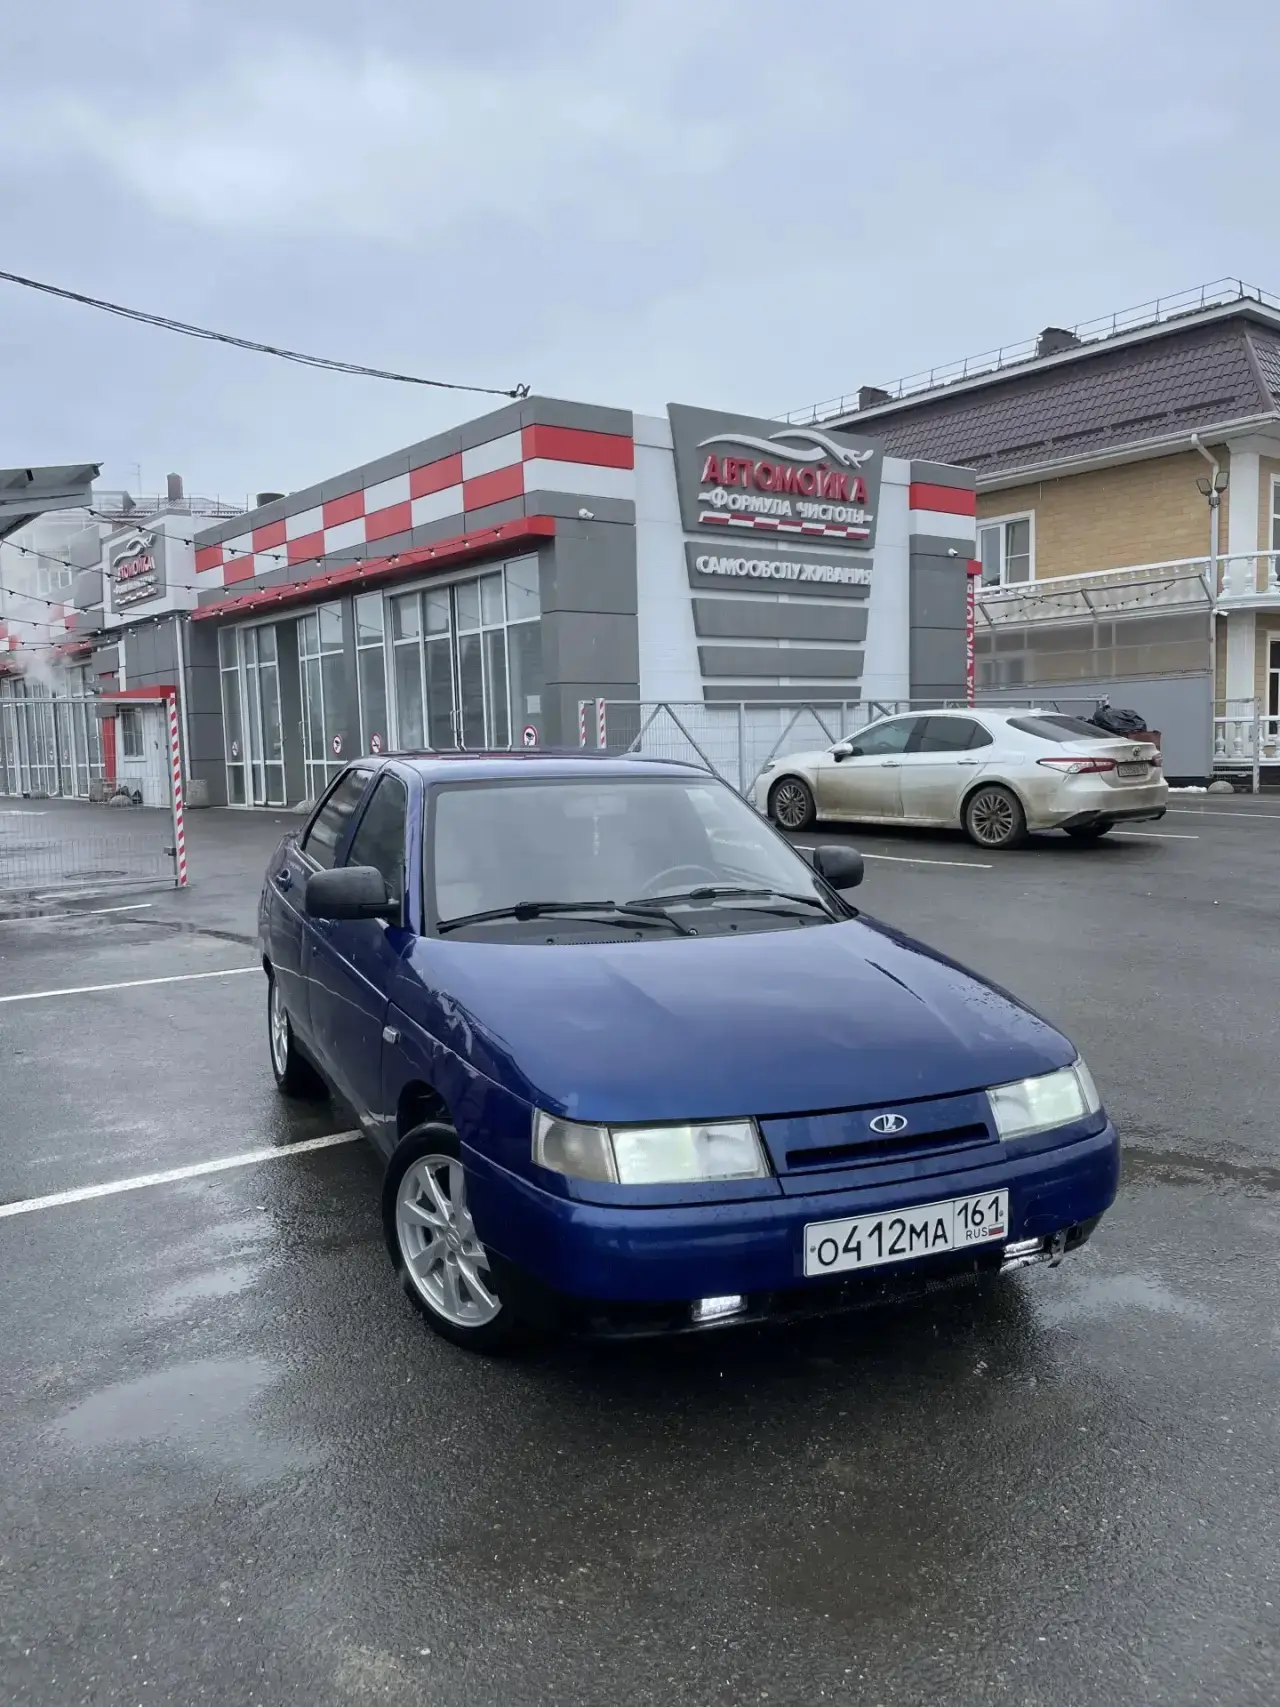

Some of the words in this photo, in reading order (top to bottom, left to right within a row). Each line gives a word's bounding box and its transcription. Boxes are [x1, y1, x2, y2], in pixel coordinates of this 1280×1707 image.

[701, 454, 869, 505] АВТОМОЙКА
[709, 486, 792, 516] ФОРМУЛА
[796, 501, 865, 524] ЧИСТОТЫ
[696, 555, 872, 586] САМООБСЛУЖИВАНИЯ
[957, 1196, 1000, 1229] 161
[965, 1227, 988, 1240] RUS
